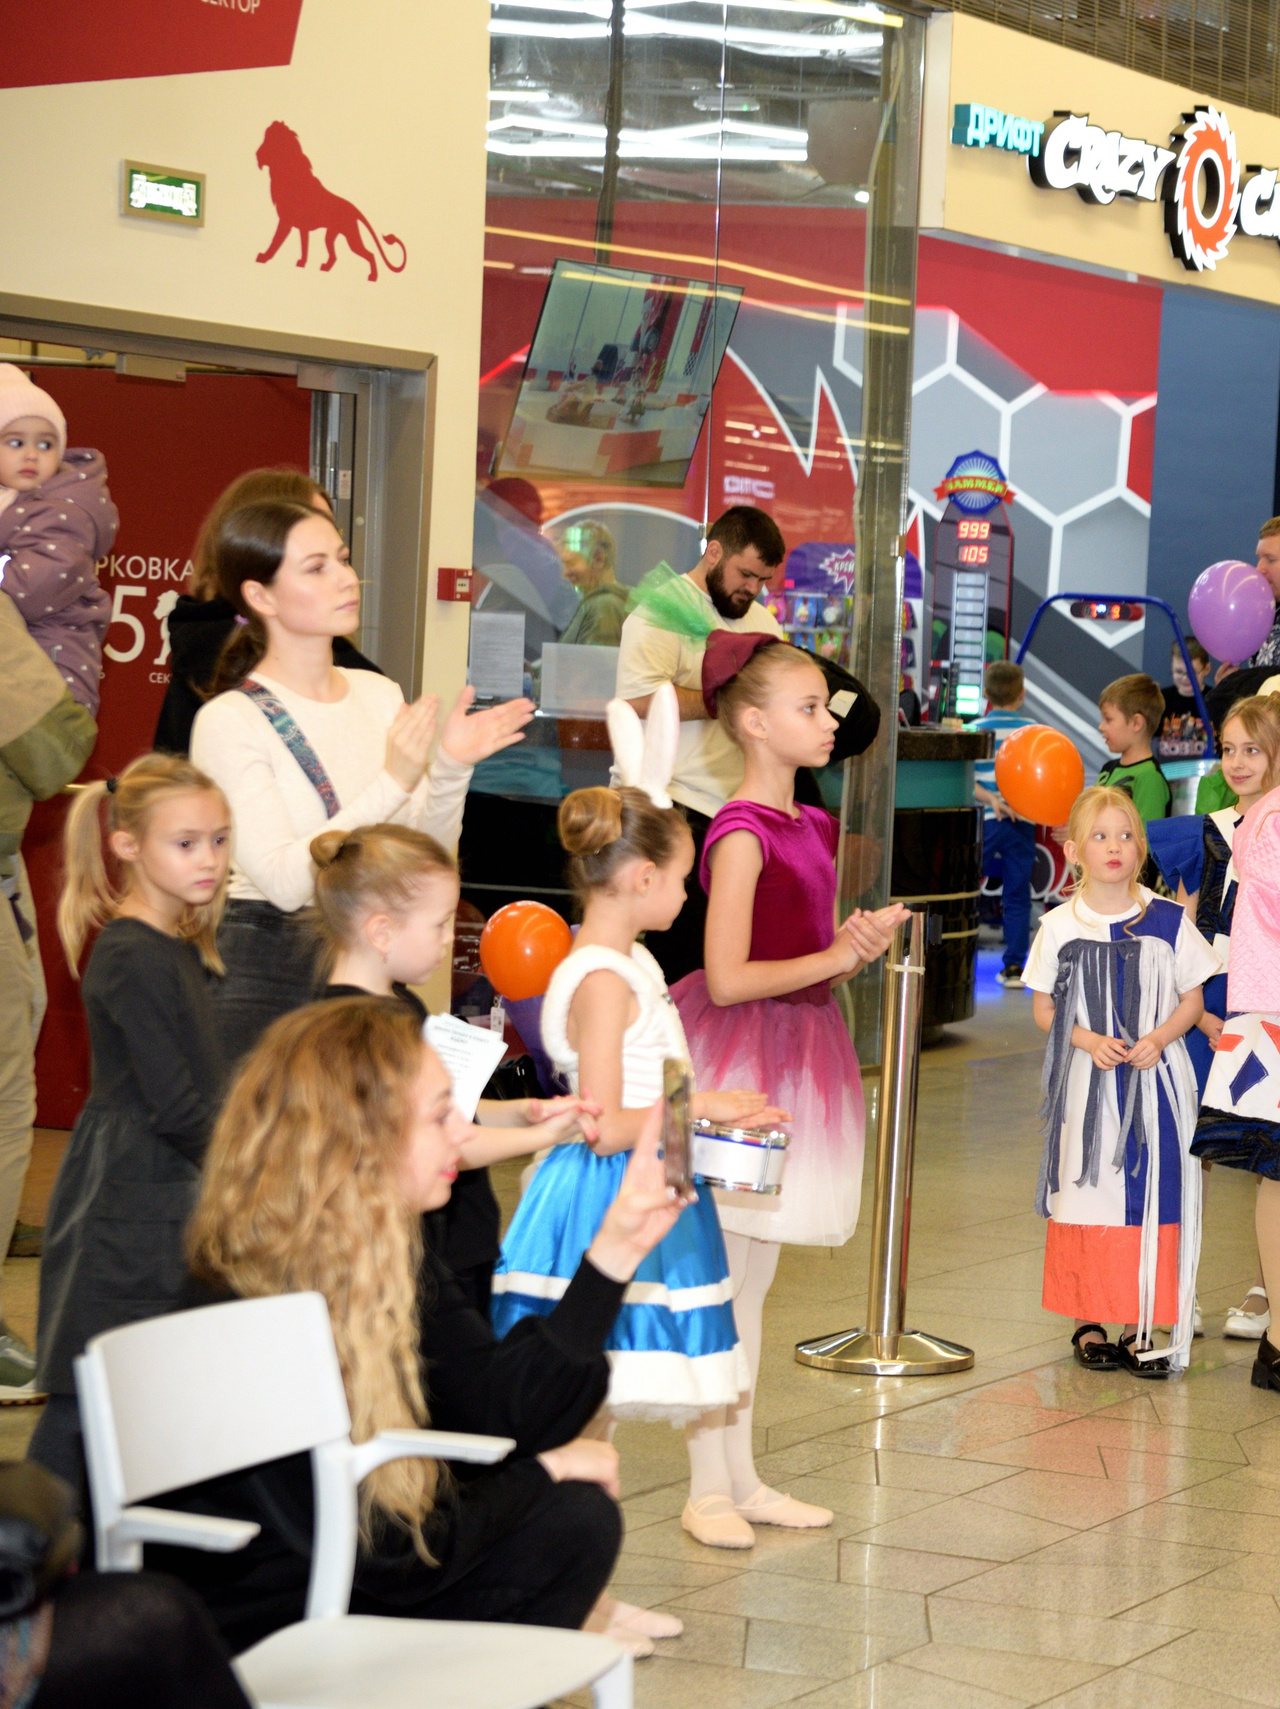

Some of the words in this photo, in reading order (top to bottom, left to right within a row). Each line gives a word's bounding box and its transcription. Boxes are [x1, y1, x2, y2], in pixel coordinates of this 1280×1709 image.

[964, 103, 1045, 157] ДРИФТ
[1043, 113, 1176, 206] CRAZY
[957, 520, 990, 540] 999
[961, 545, 989, 563] 105
[94, 554, 195, 582] РКОВКА
